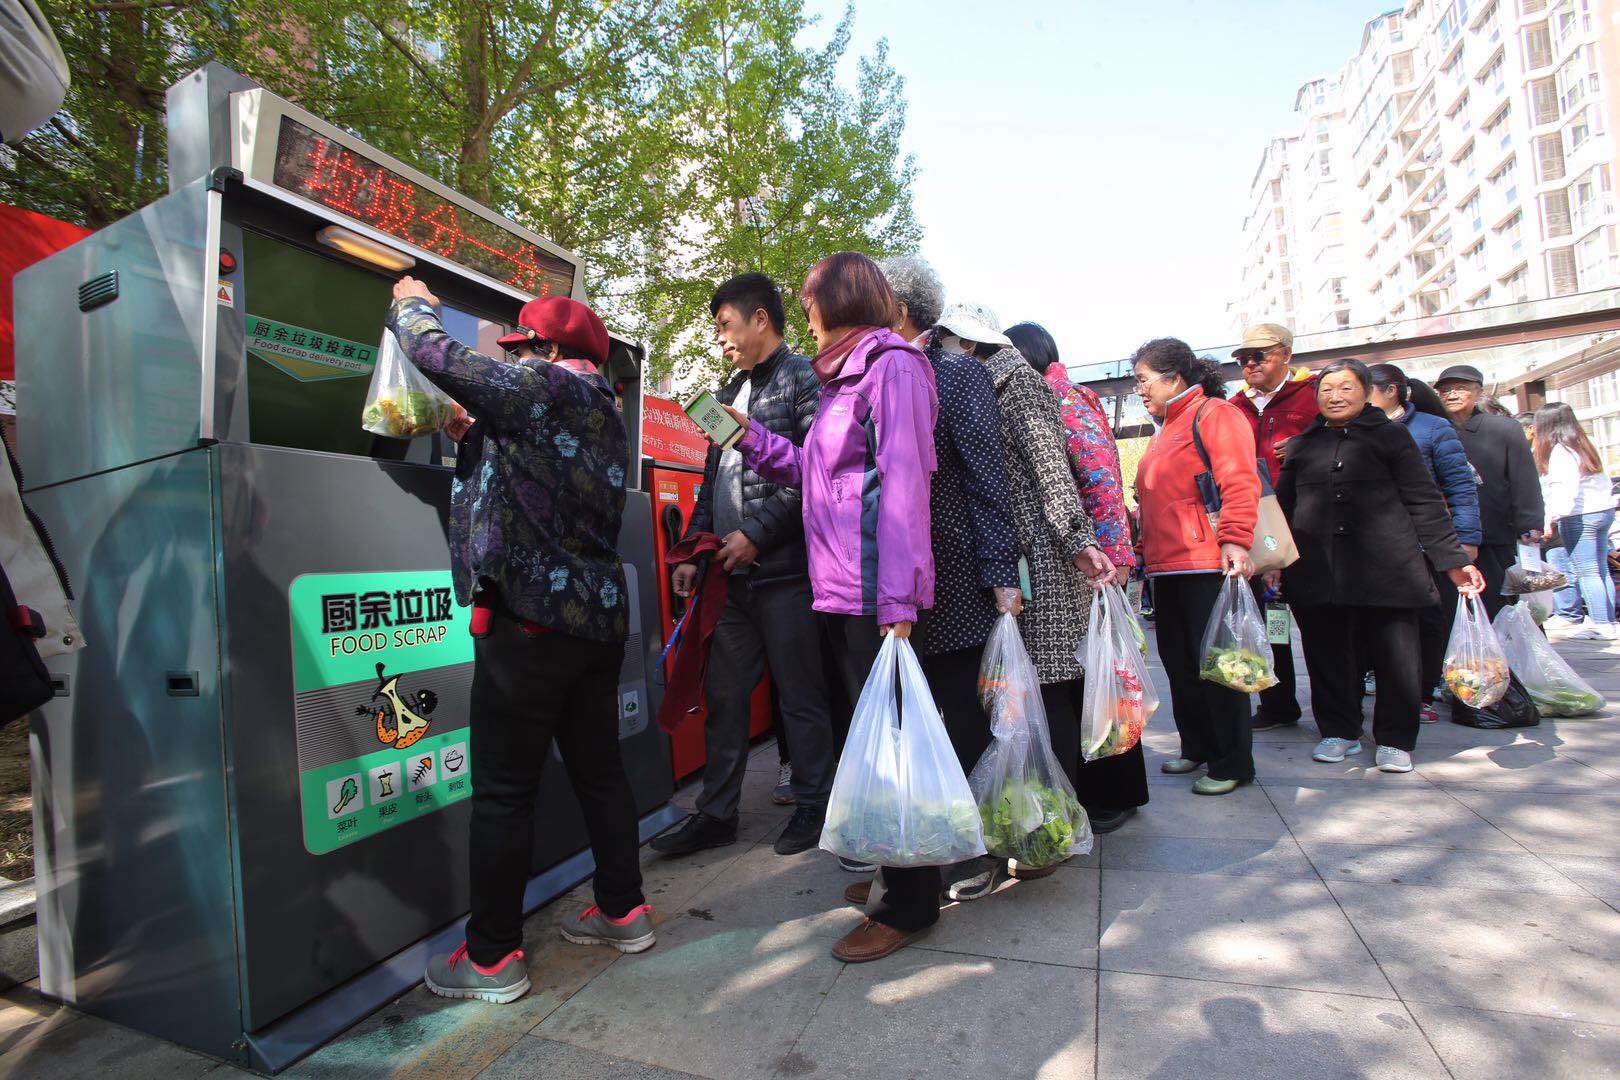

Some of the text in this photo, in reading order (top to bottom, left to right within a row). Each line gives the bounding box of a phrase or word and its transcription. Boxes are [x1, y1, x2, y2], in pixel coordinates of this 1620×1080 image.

[253, 321, 371, 361] 厨余垃圾投放口
[254, 338, 362, 370] Food scrap delivery port
[321, 587, 454, 634] 厨余垃圾
[330, 625, 448, 656] FOOD SCRAP
[336, 816, 358, 834] 菜叶
